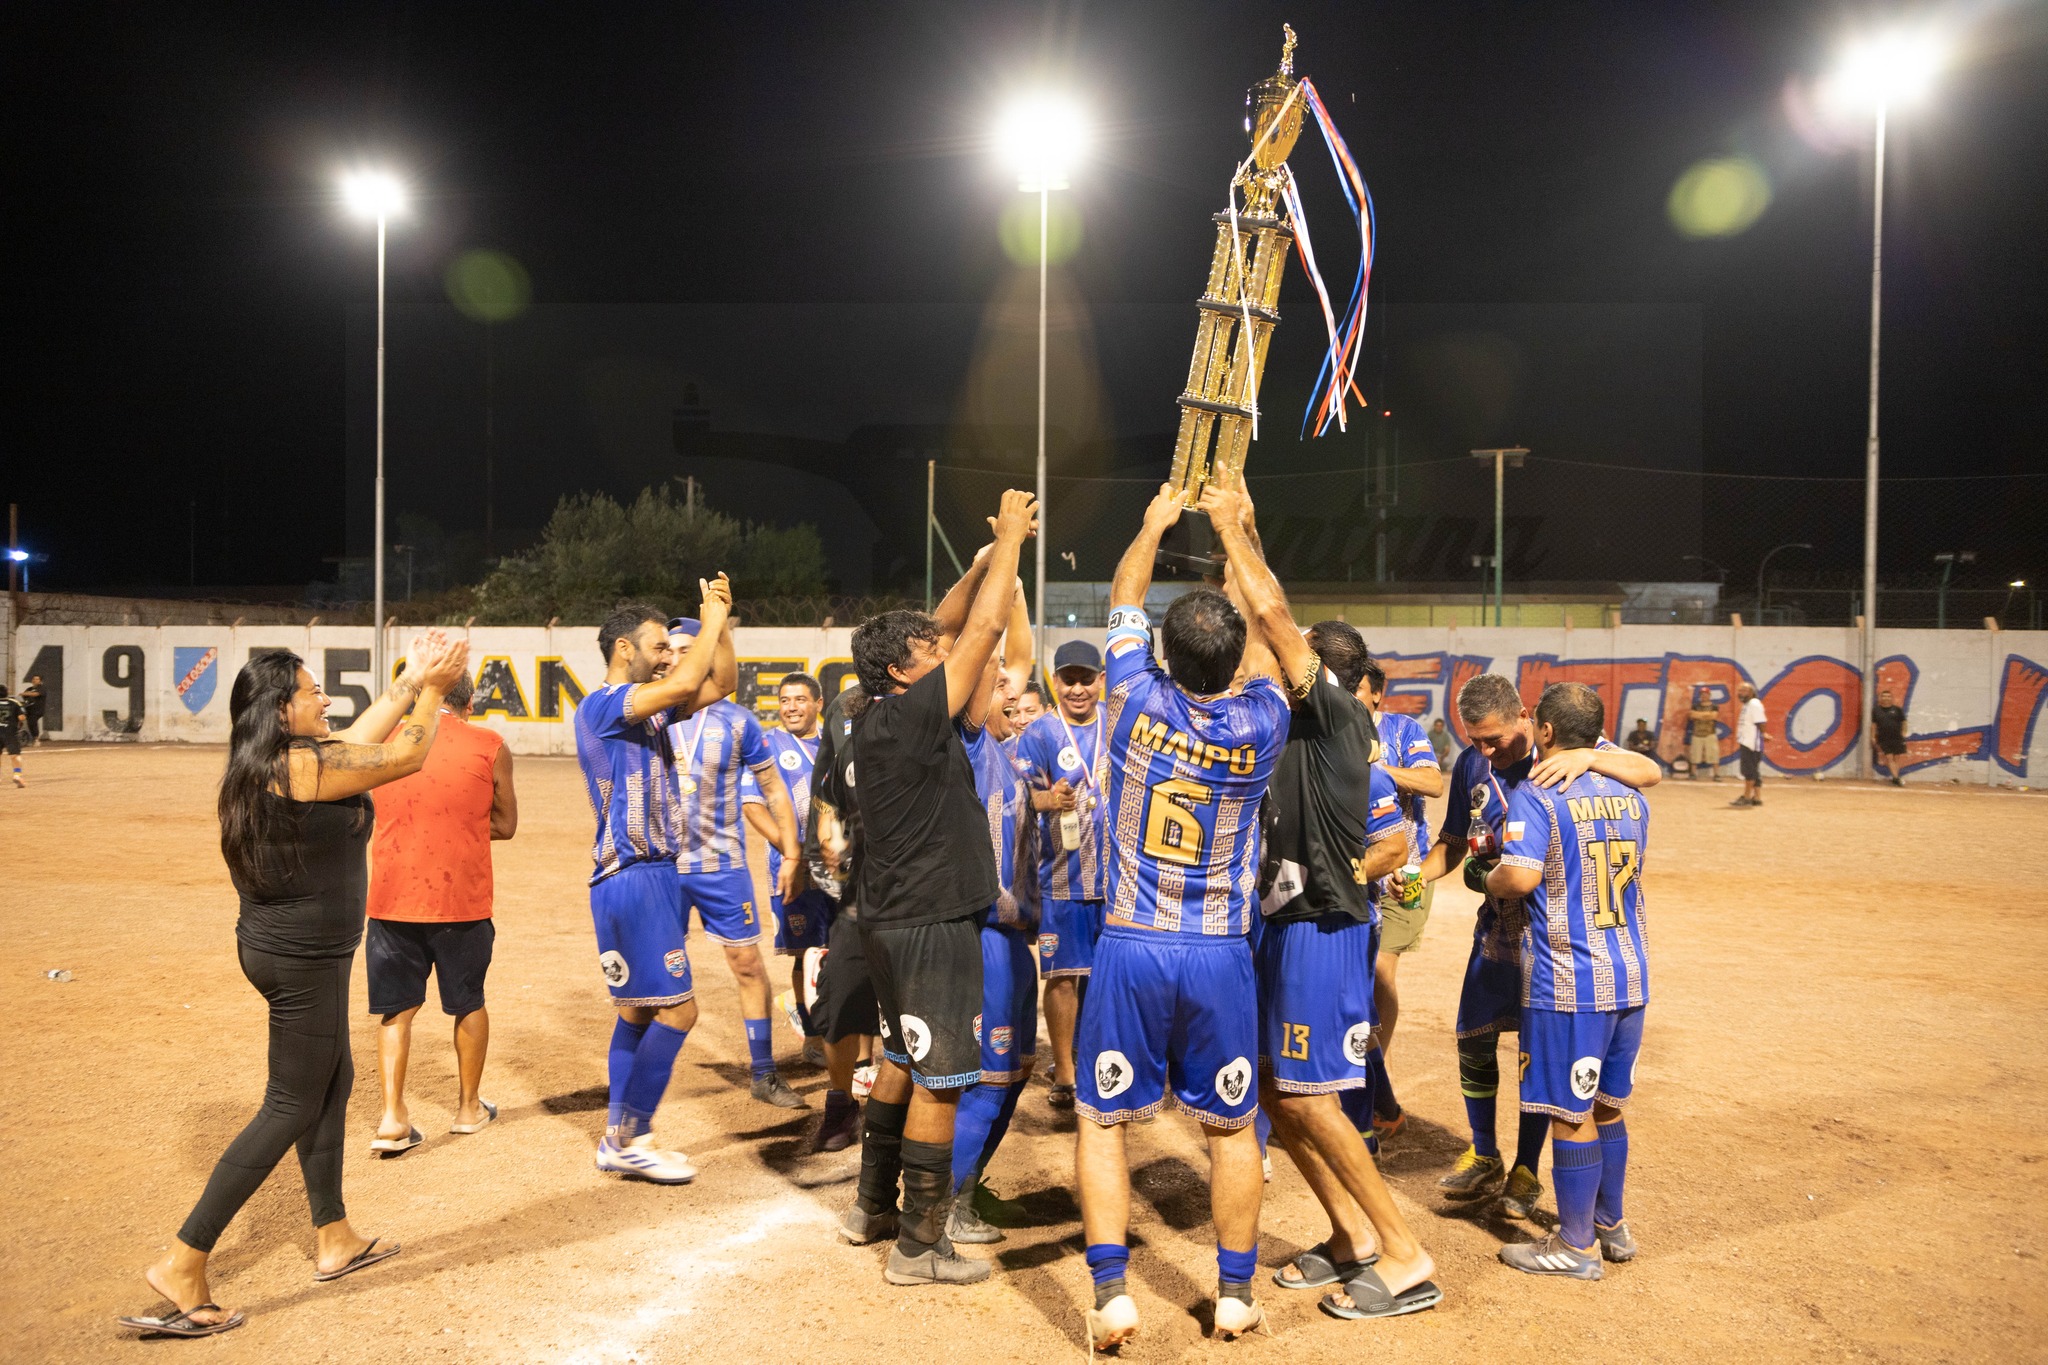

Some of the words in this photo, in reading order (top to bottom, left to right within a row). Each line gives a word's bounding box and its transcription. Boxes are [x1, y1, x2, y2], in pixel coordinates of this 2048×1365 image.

[1129, 712, 1257, 775] MAIPÚ
[1144, 777, 1213, 867] 6
[1566, 794, 1642, 823] MAIPÚ
[1587, 839, 1637, 929] 17
[742, 901, 754, 925] 3
[1280, 1021, 1311, 1062] 13
